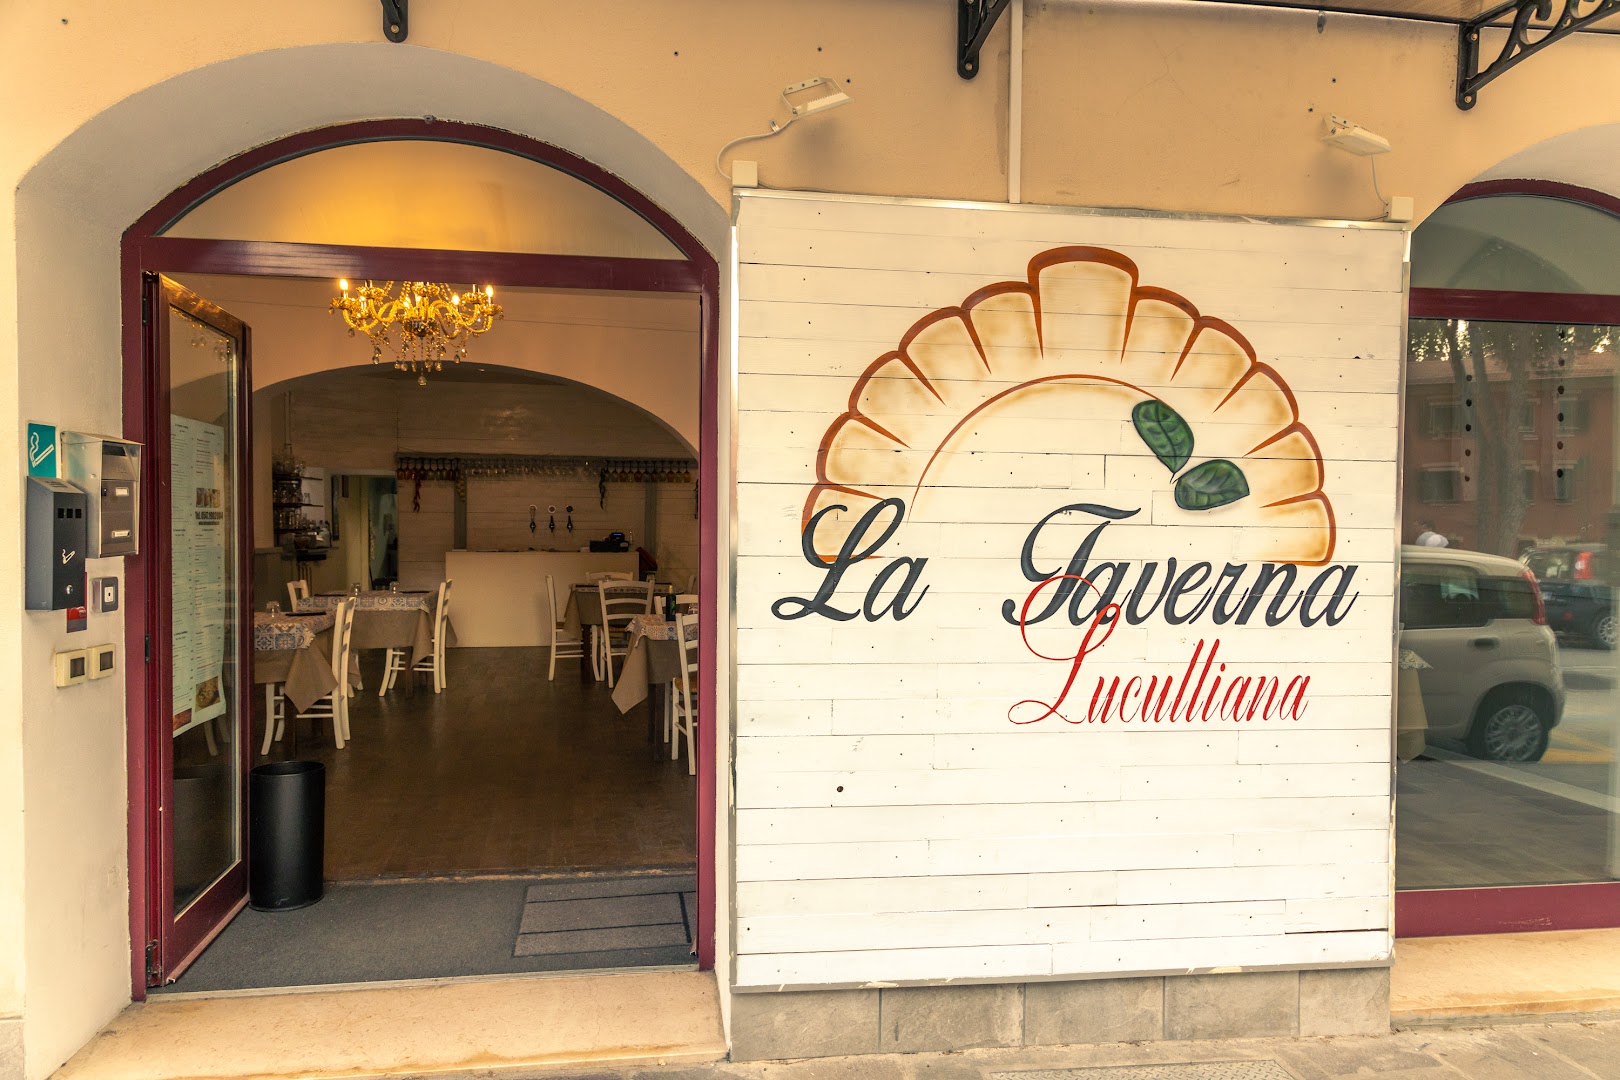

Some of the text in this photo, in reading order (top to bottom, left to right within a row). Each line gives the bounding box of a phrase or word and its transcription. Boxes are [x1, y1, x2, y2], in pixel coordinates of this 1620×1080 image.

[772, 497, 1360, 626] La Taverna
[1008, 575, 1312, 725] Luculliana
